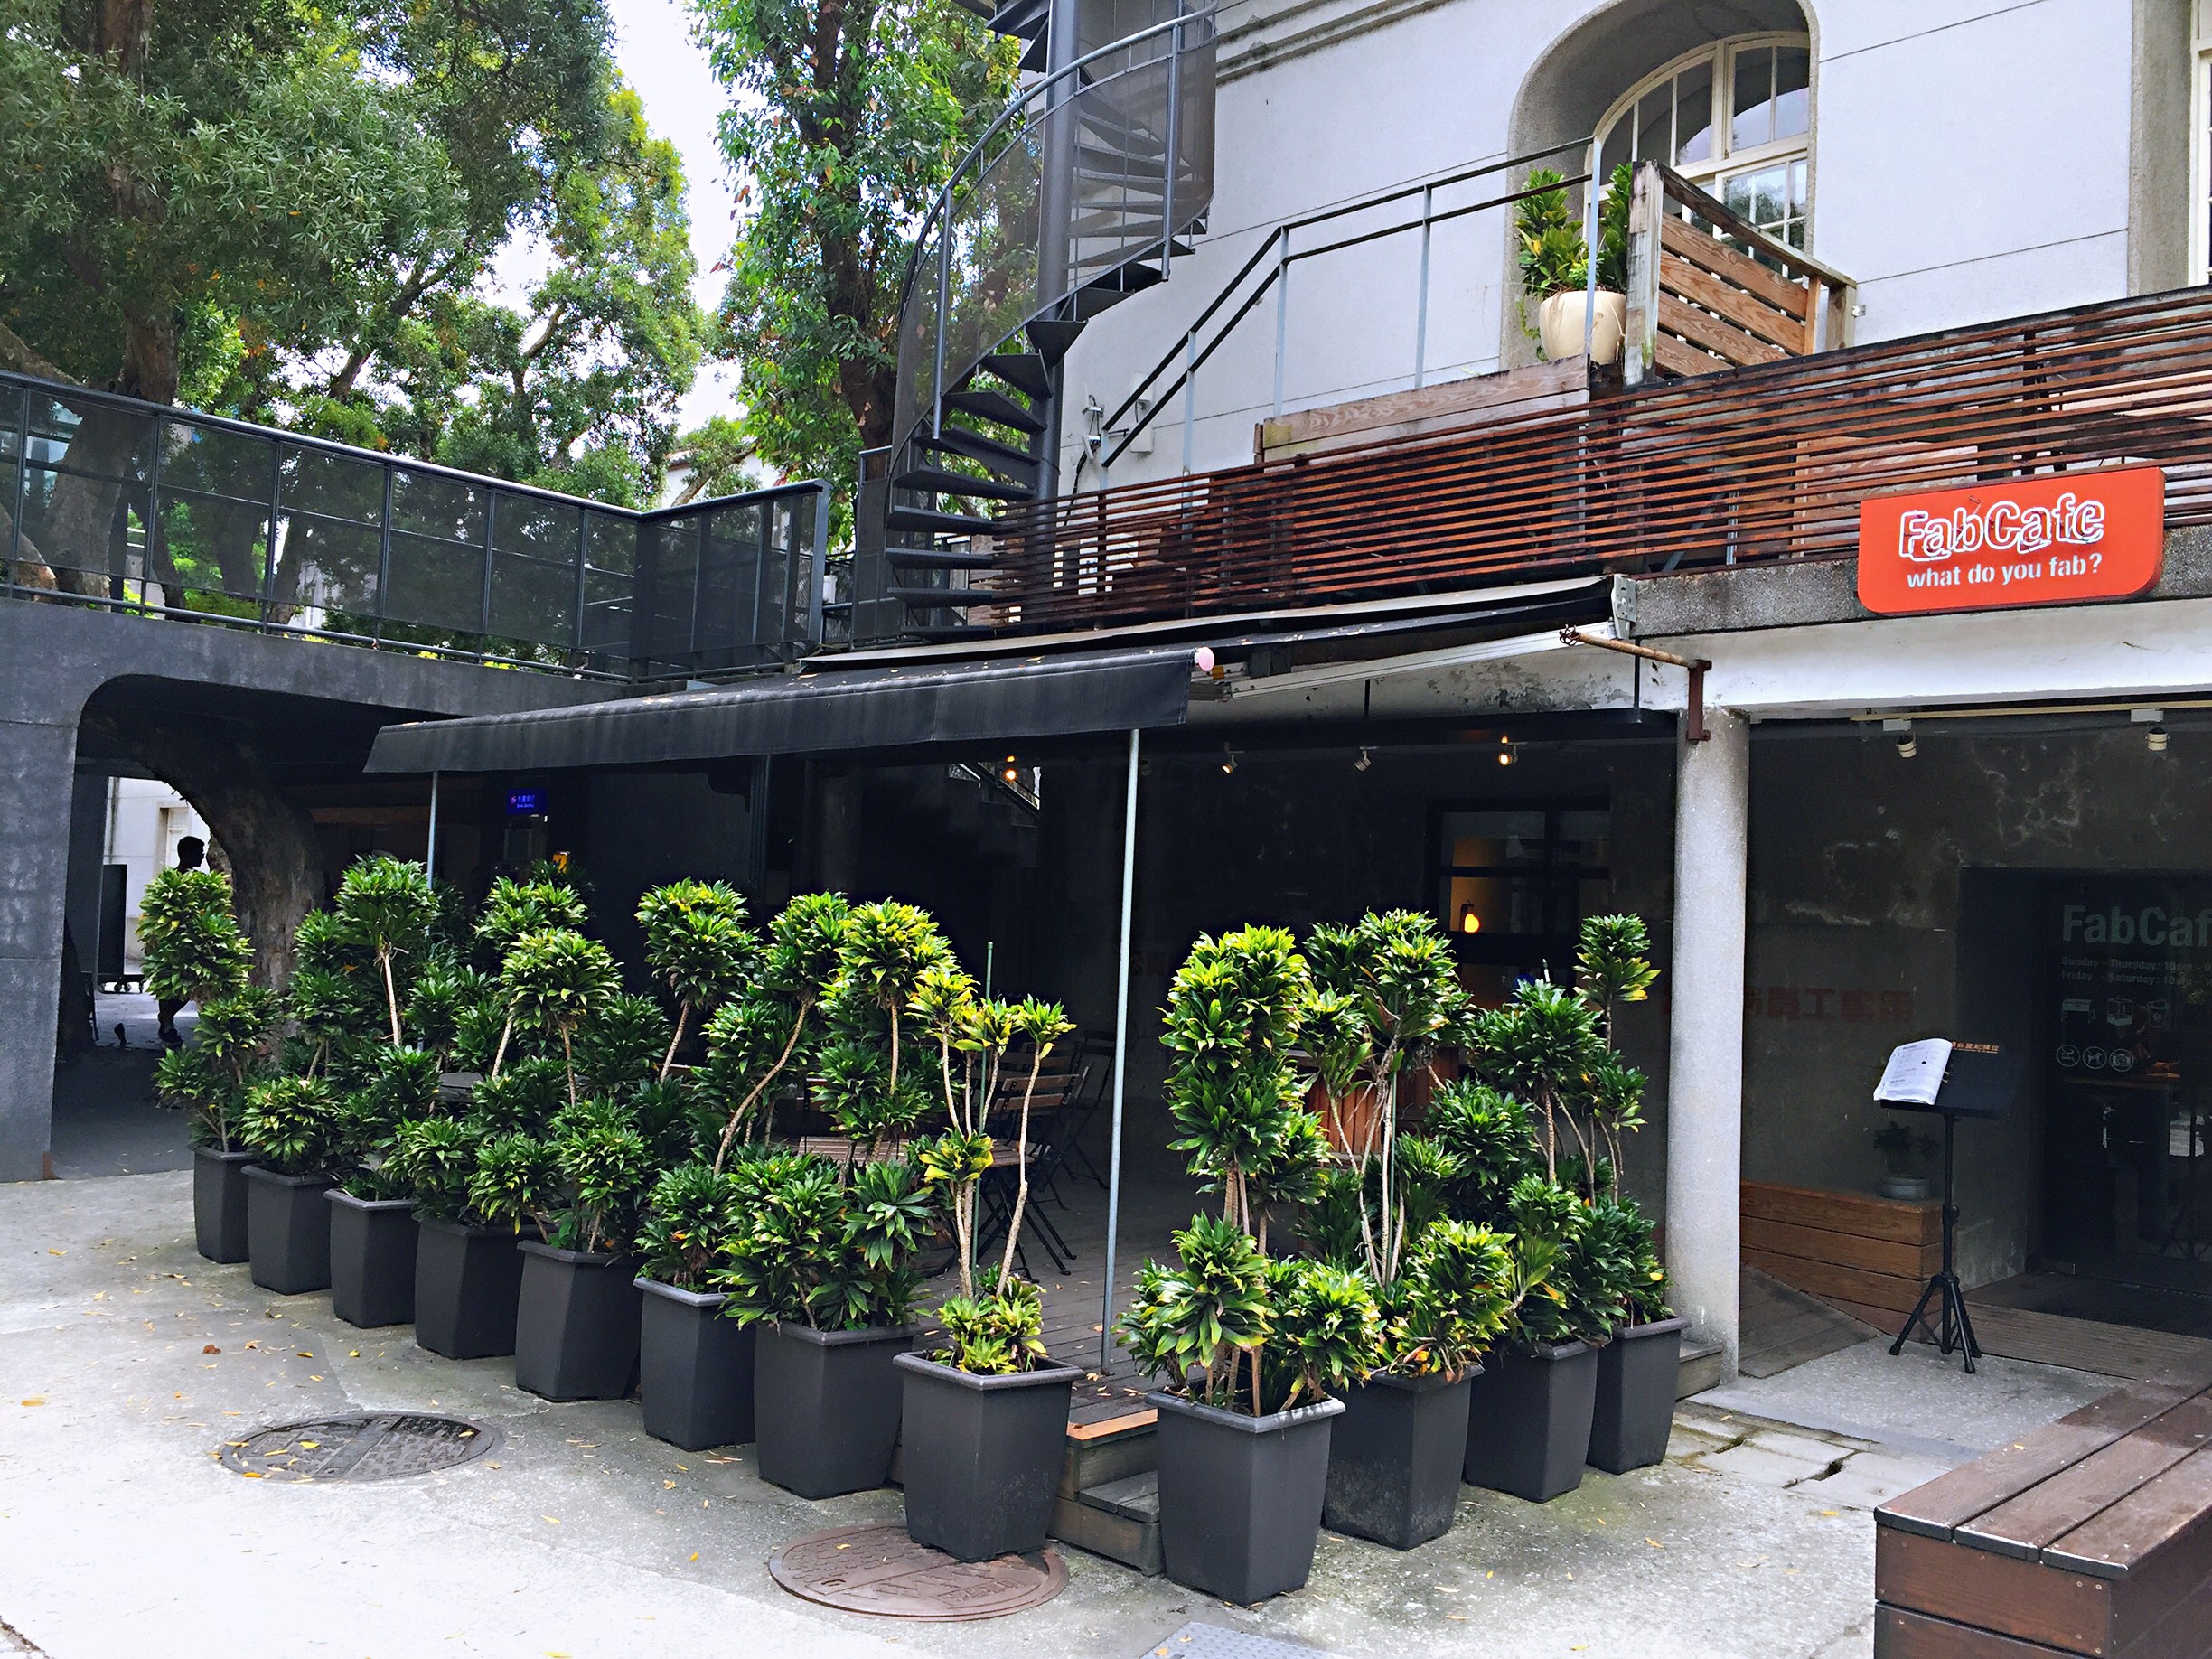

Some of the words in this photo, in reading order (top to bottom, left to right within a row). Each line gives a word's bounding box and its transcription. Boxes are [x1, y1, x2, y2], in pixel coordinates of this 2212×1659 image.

[1898, 492, 2105, 562] FabCafe
[1907, 565, 1962, 588] what
[1967, 563, 1995, 584] do
[2001, 562, 2042, 586] you
[2048, 552, 2104, 577] fab?
[2061, 956, 2098, 969] Sunday
[2061, 970, 2094, 983] Friday
